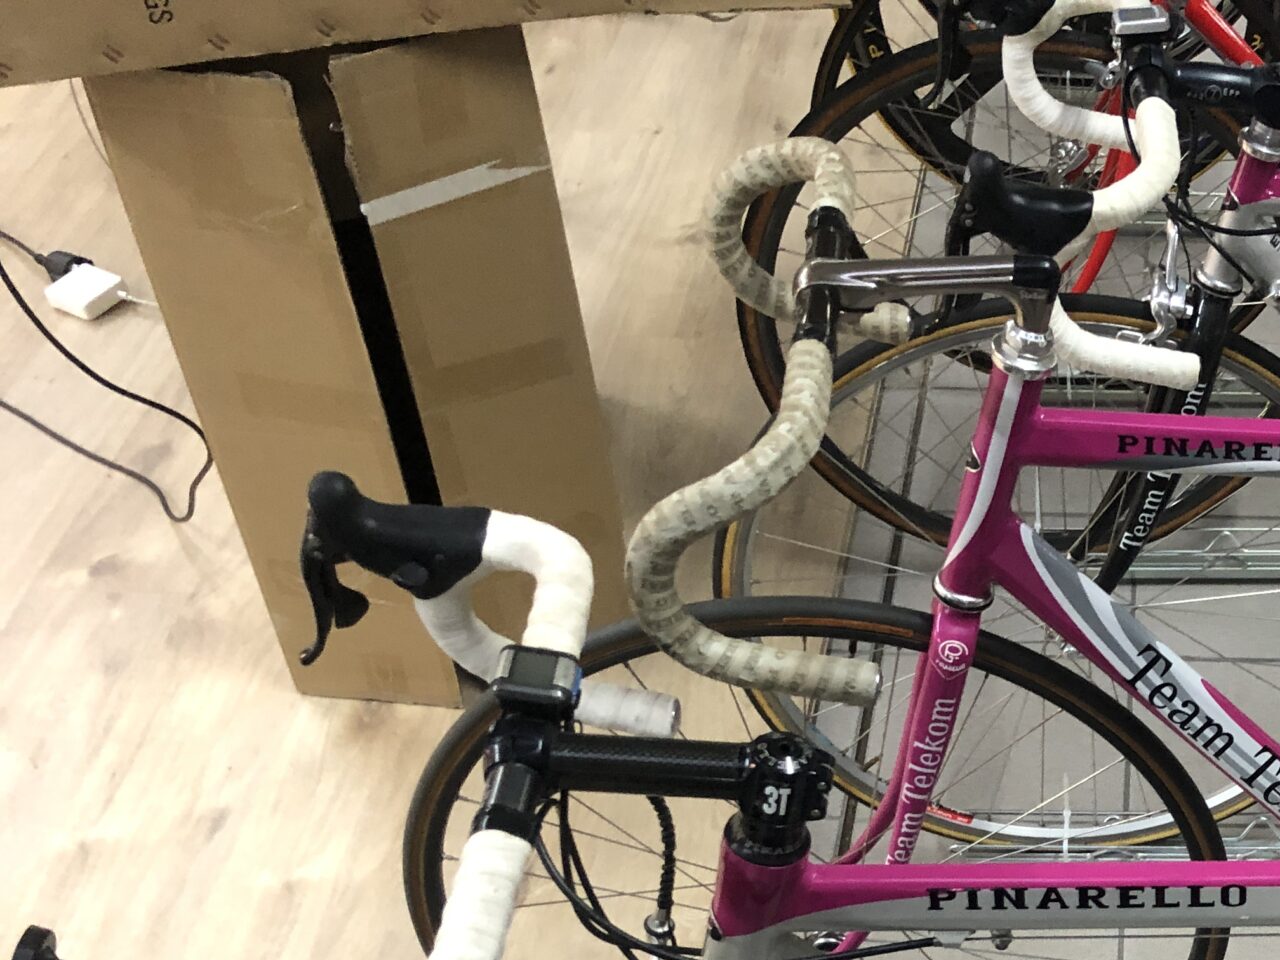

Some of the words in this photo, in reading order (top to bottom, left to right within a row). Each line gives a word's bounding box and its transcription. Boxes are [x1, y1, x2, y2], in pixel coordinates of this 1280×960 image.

[1120, 486, 1157, 551] Team
[1125, 643, 1235, 760] Team
[902, 697, 956, 804] Telekom
[762, 785, 792, 816] 3T
[927, 884, 1248, 911] PINARELLO
